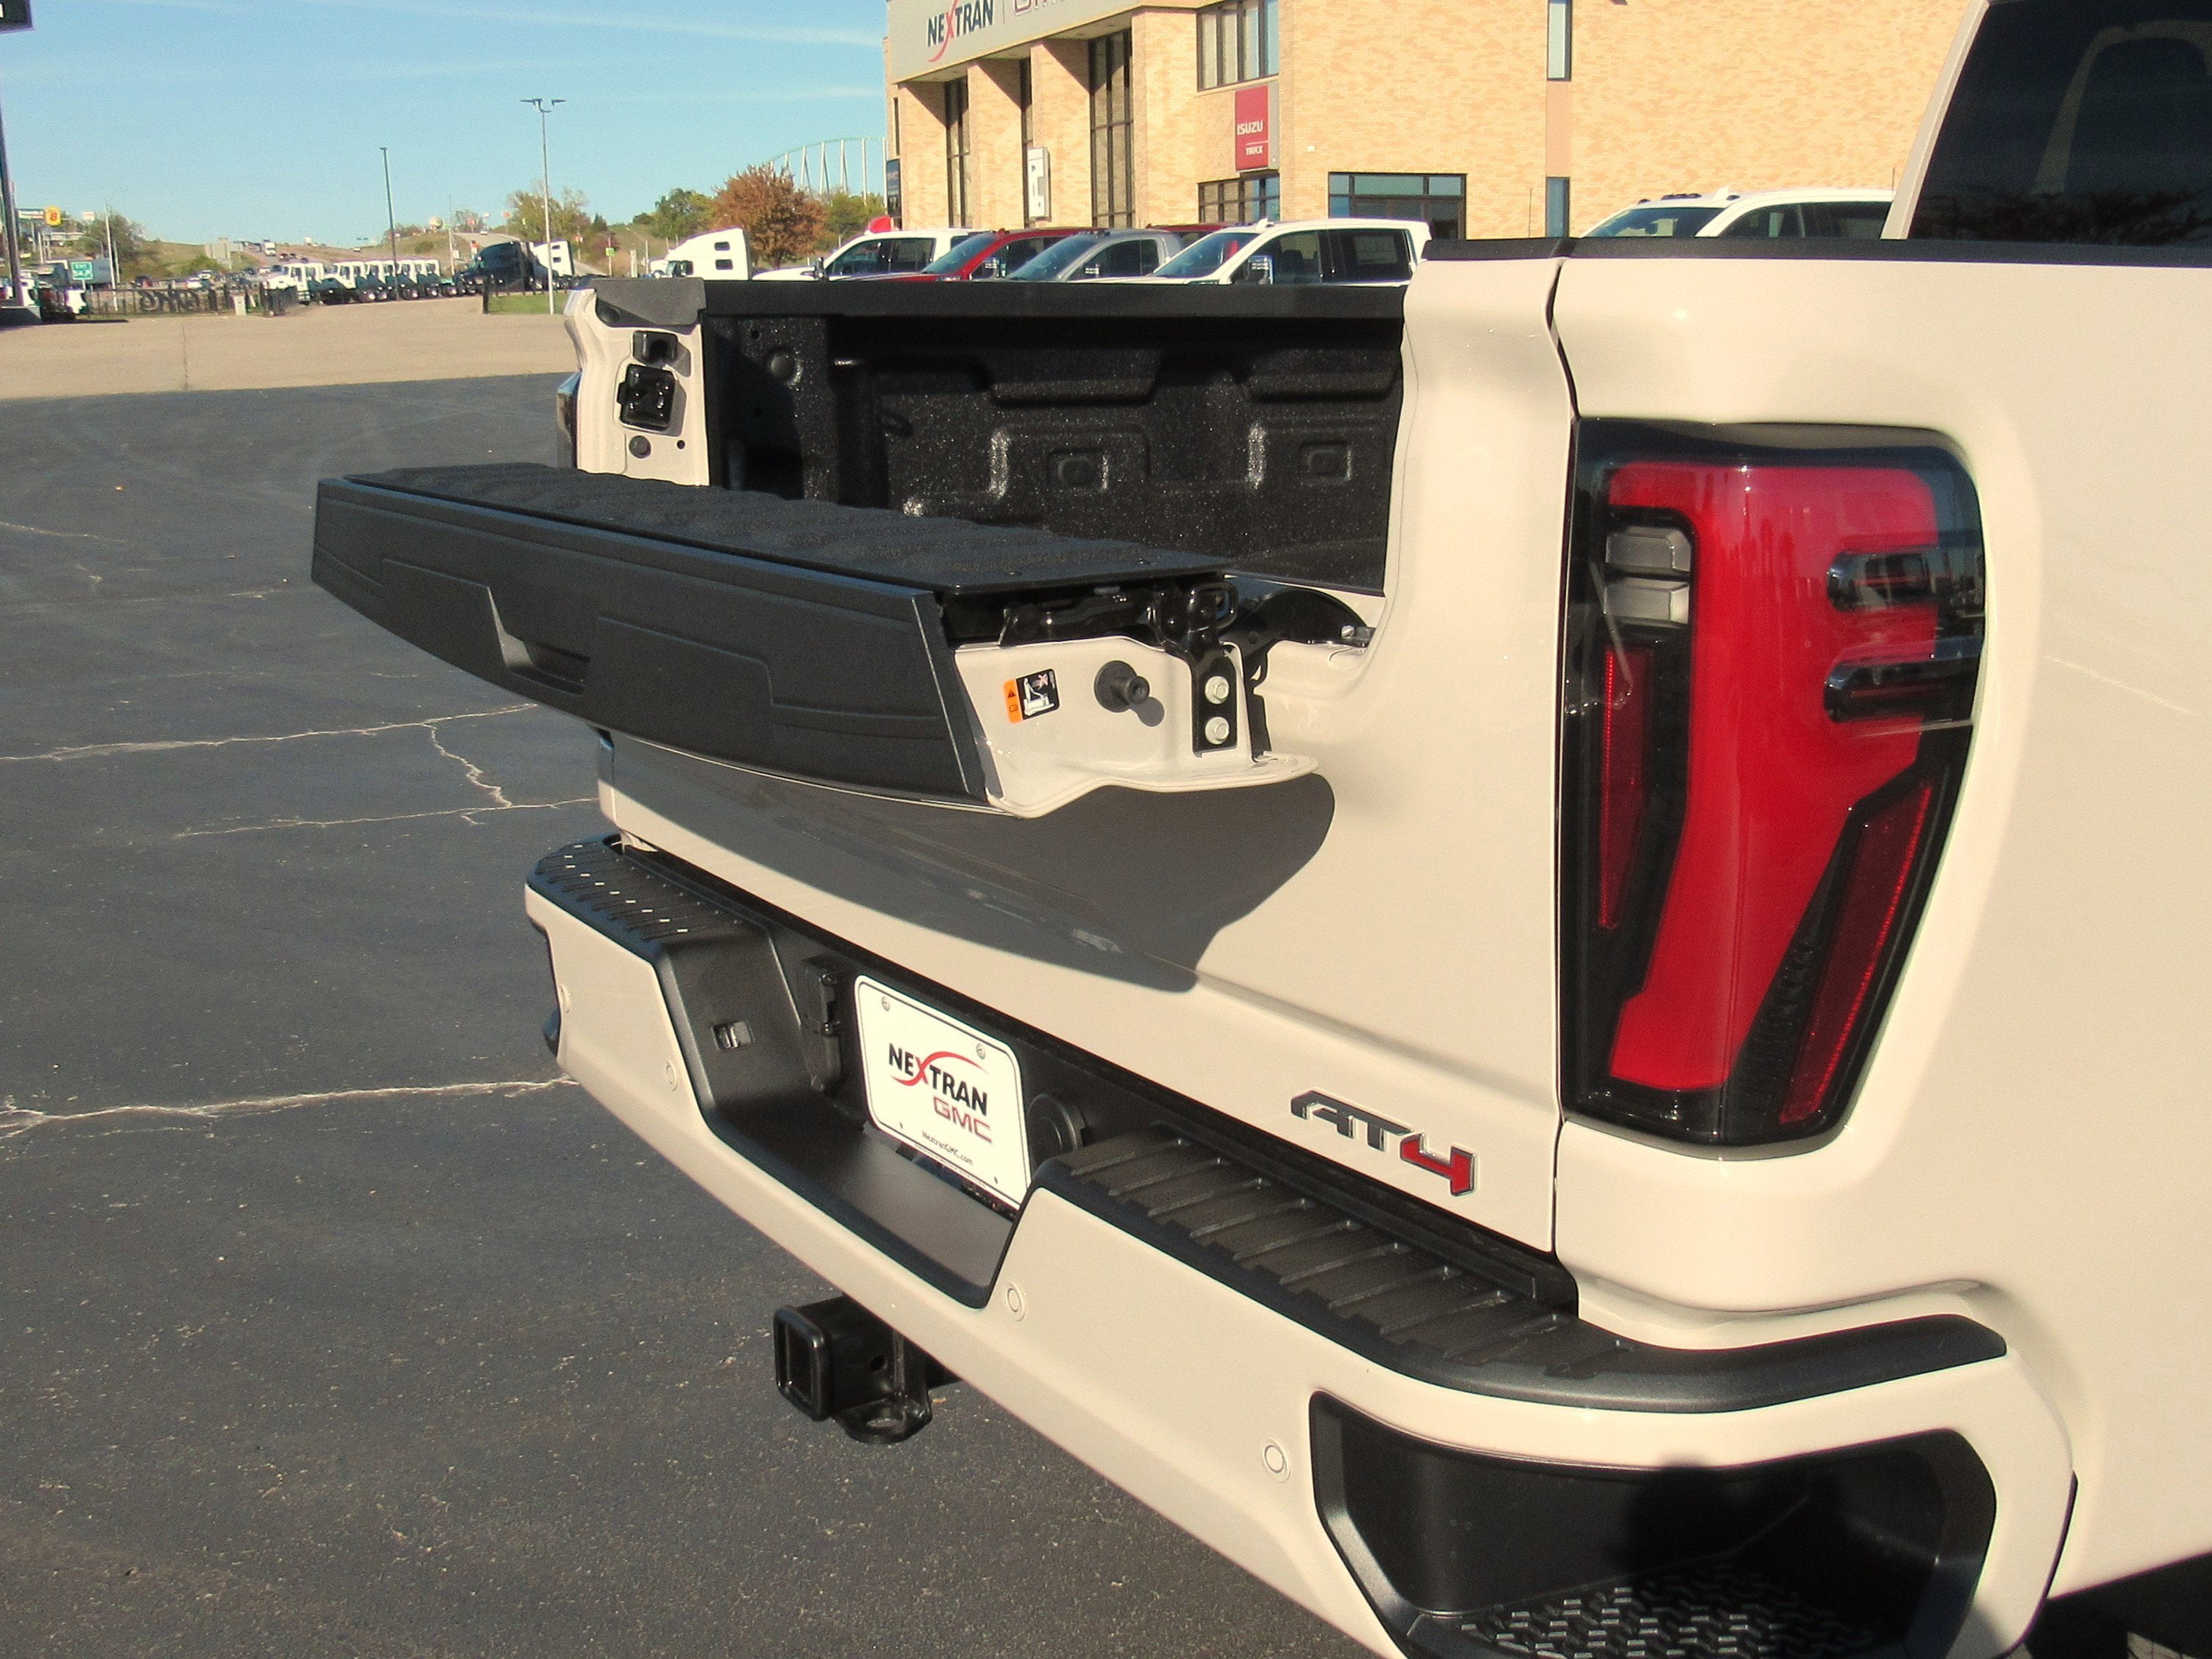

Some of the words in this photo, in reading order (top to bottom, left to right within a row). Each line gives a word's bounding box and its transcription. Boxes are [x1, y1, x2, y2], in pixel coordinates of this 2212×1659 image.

[927, 0, 994, 48] NEXTRAN
[1237, 119, 1264, 136] ISUZU
[1245, 145, 1263, 156] TRUCK
[888, 1042, 988, 1117] NEXTRAN
[933, 1095, 993, 1145] GMC
[1290, 1089, 1477, 1196] AT4
